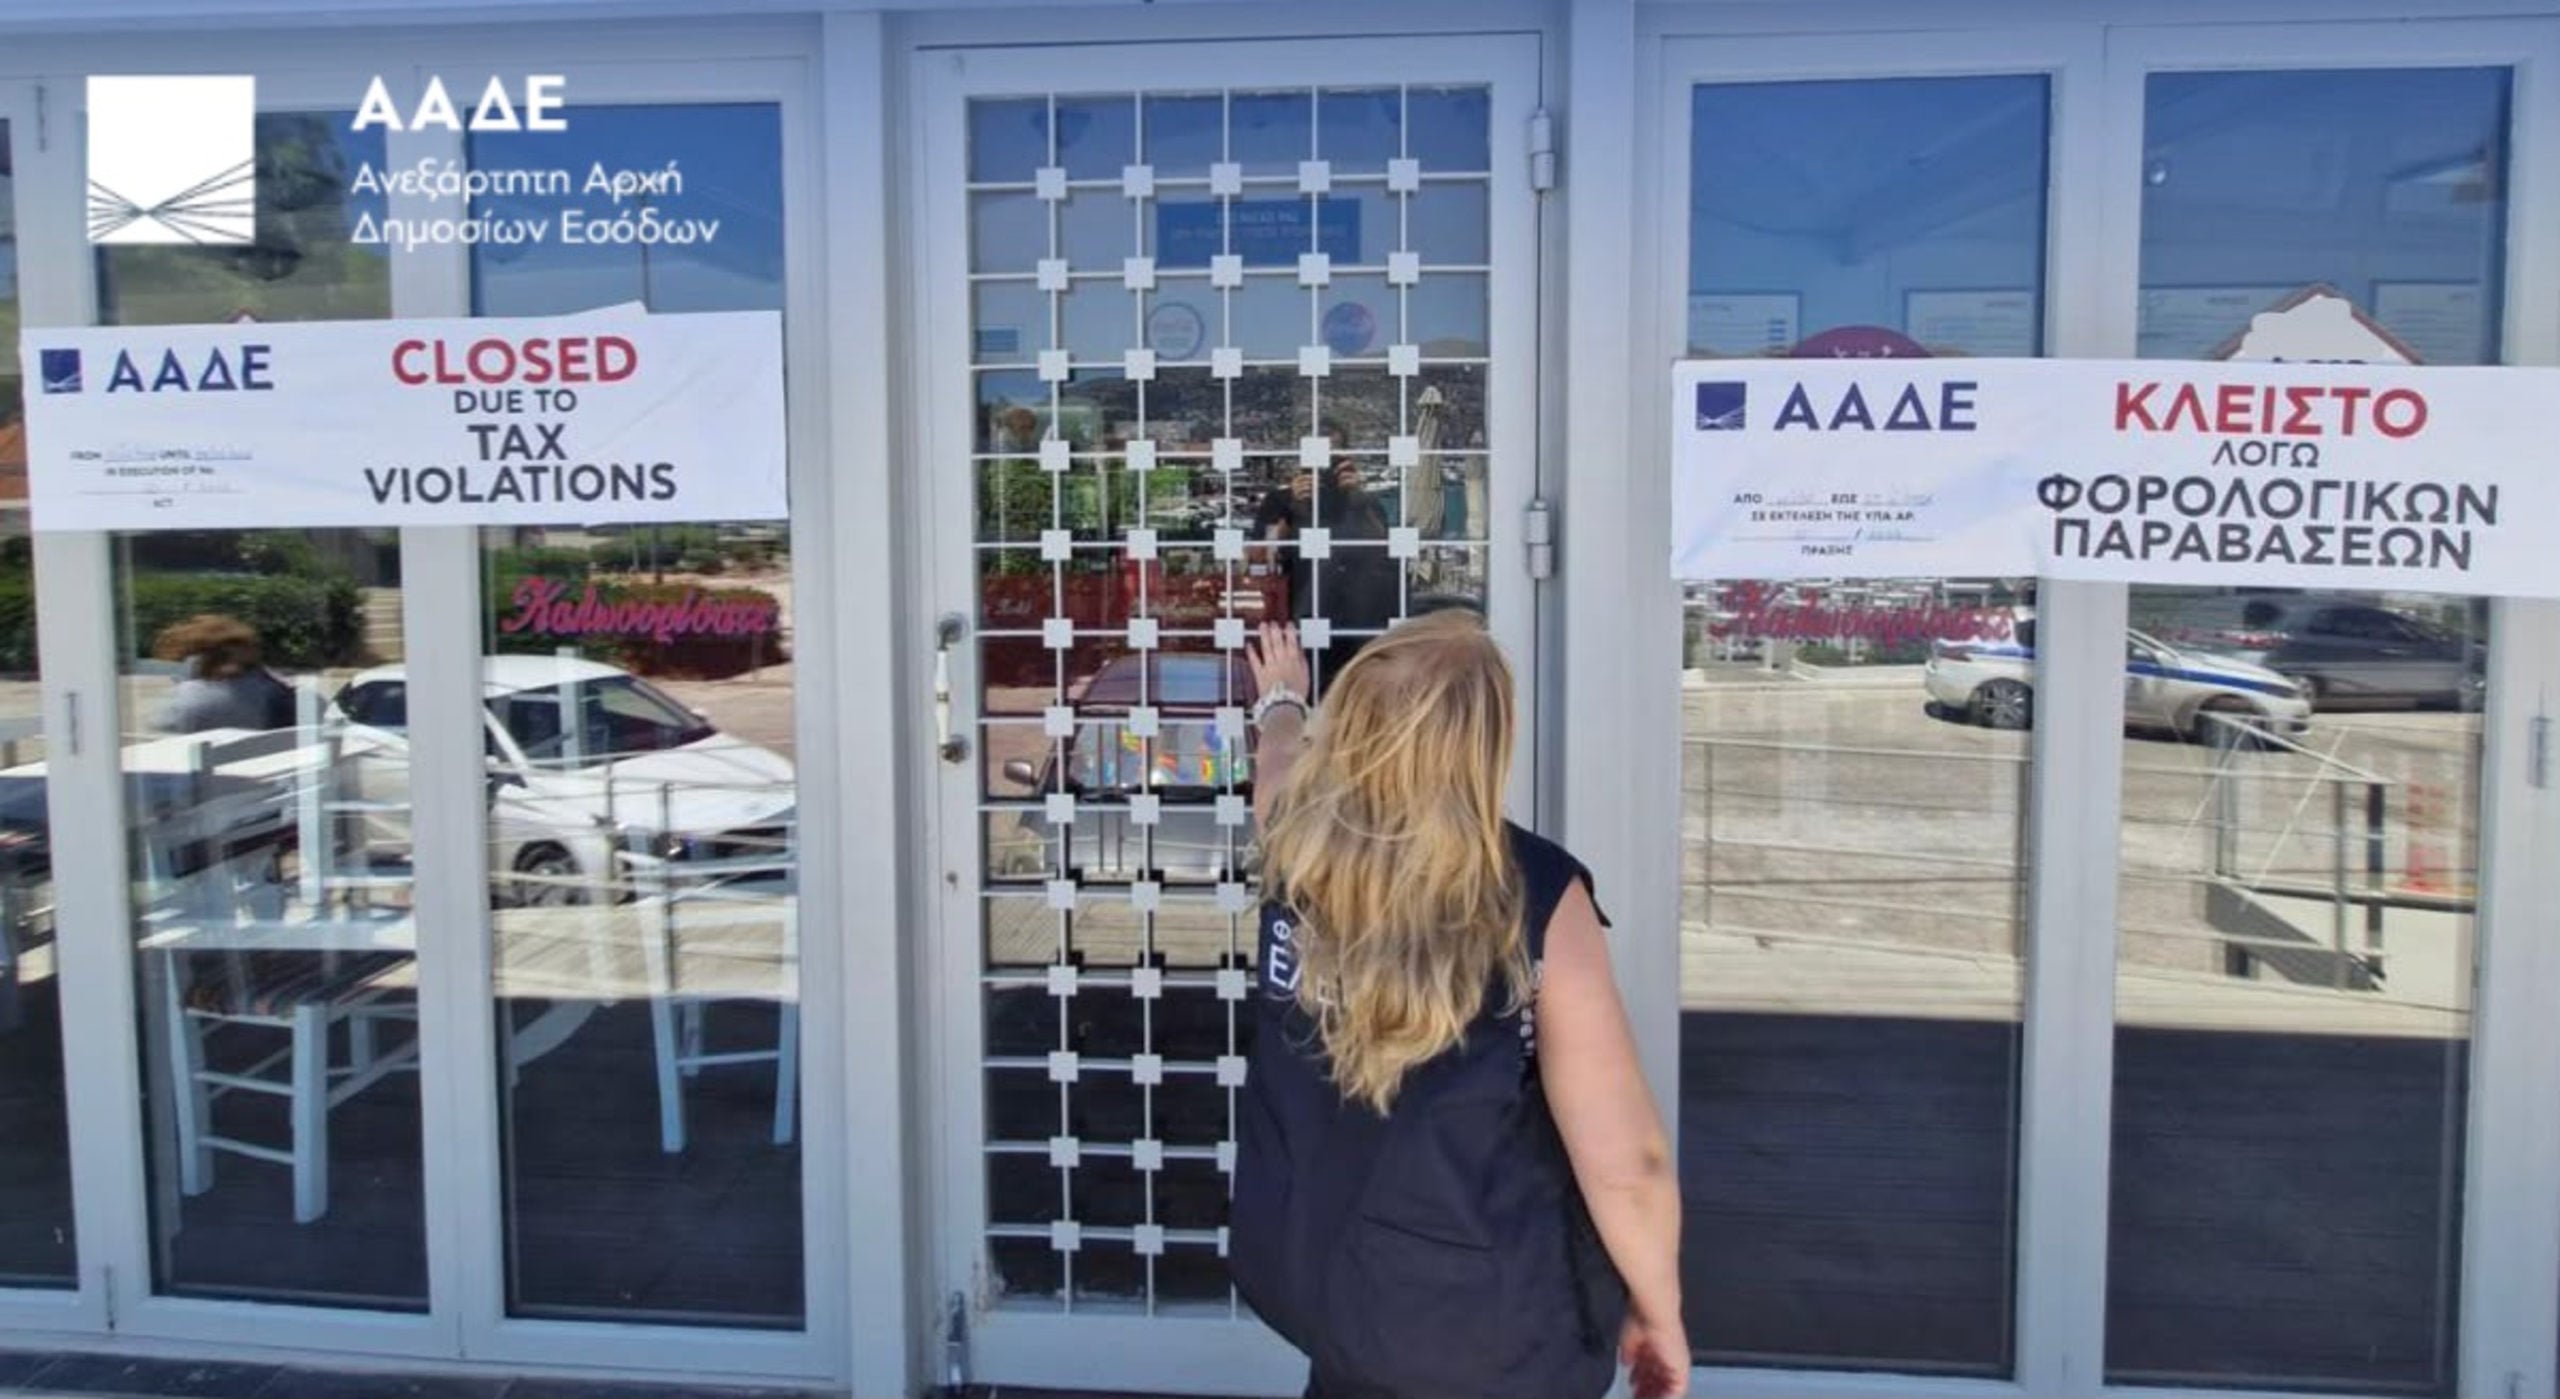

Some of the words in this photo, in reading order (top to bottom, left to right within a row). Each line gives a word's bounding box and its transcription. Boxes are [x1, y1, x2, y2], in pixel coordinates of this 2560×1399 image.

[106, 345, 274, 393] ΑΑΔΕ
[391, 336, 638, 385] CLOSED
[454, 389, 524, 413] DUE
[533, 389, 577, 412] TO
[1772, 381, 1978, 431] ΑΑΔΕ
[2114, 381, 2429, 438] ΚΛΕΙΣΤΟ
[466, 423, 567, 461] TAX
[2212, 440, 2321, 468] ΛΟΓΩ
[363, 463, 678, 505] VIOLATIONS
[2036, 473, 2499, 526] ΦΟΡΟΛΟΓΙΚΩΝ
[2053, 518, 2472, 571] ΠΑΡΑΒΑΣΕΩΝ
